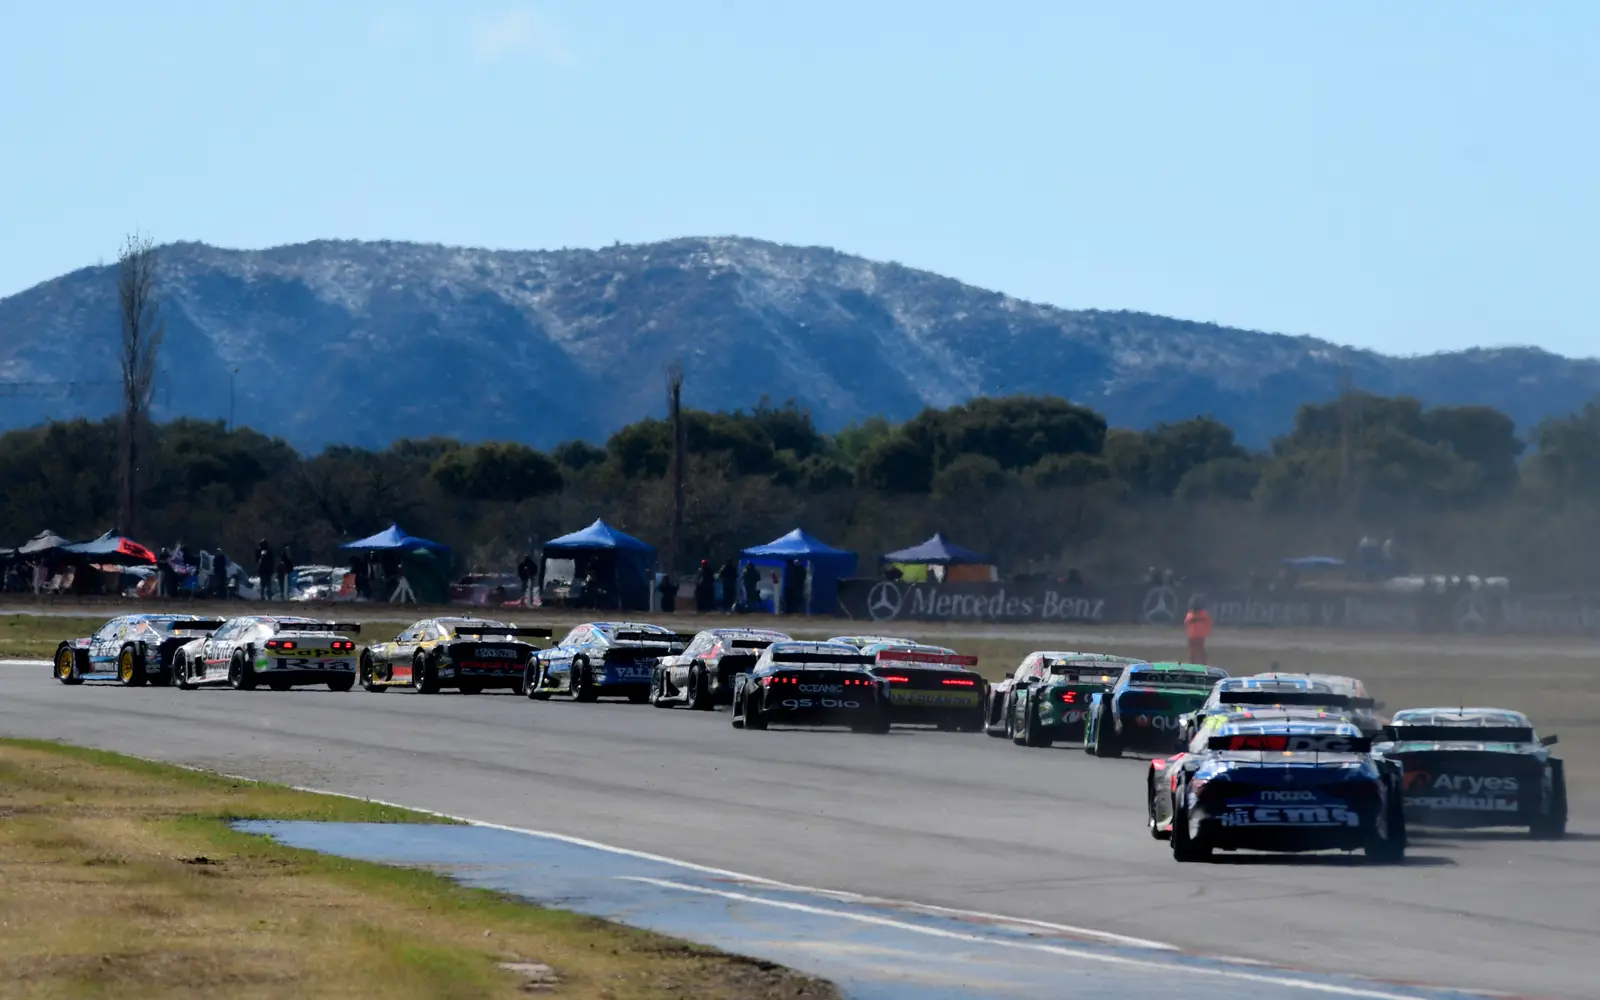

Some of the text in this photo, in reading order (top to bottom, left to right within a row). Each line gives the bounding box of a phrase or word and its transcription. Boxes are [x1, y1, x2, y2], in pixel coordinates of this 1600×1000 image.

[910, 585, 1105, 619] Mercedes-Benz
[798, 683, 845, 693] OCEANIC
[1433, 773, 1520, 795] Aryes
